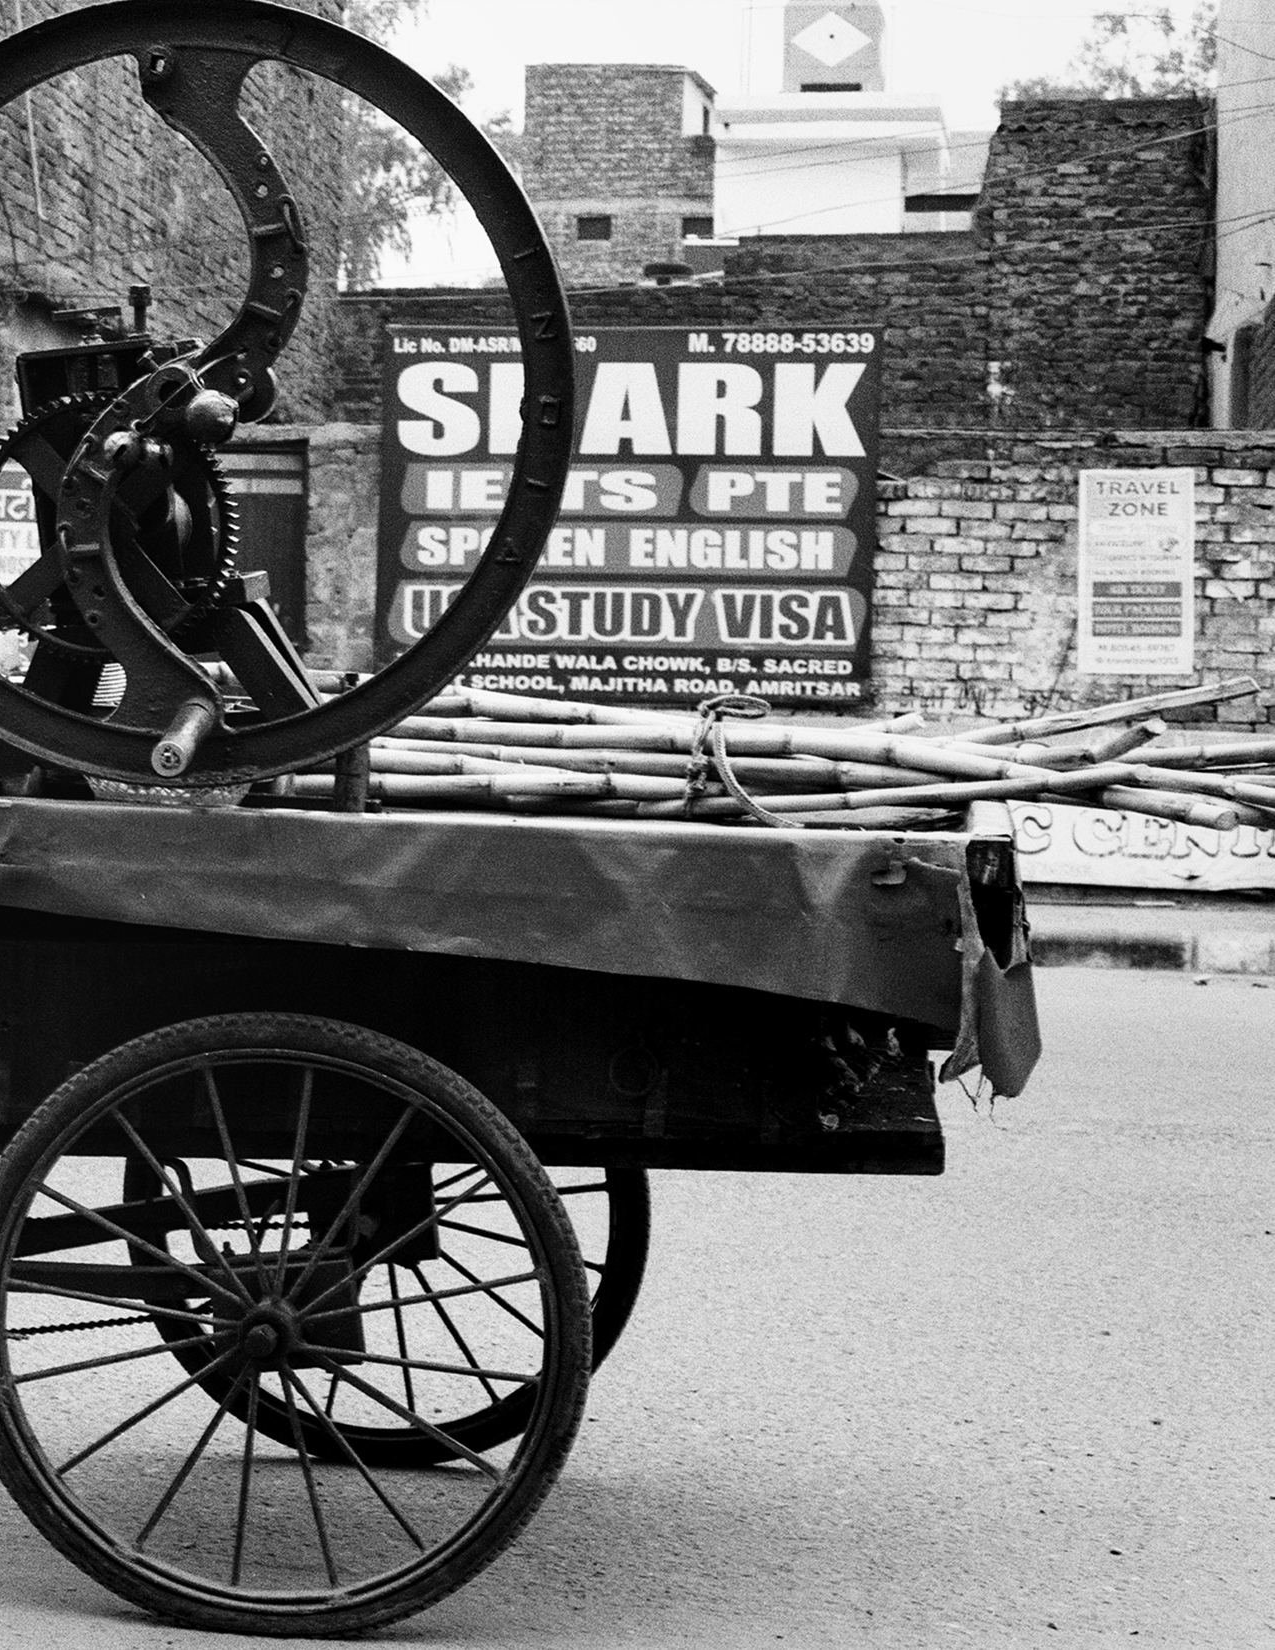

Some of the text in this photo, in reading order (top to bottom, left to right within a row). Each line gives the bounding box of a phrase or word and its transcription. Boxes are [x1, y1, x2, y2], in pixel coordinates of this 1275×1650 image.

[394, 336, 418, 353] Lic
[421, 336, 446, 353] No.
[688, 333, 716, 353] M.
[722, 333, 875, 353] 78888-53639
[426, 469, 843, 513] IETS PTE
[1096, 481, 1180, 495] TRAVEL
[1108, 502, 1168, 517] ZONE
[629, 529, 834, 571] ENGLISH
[522, 586, 706, 643] STUDY
[713, 588, 856, 646] VISA
[468, 653, 853, 676] HANDE WALA CHOWK, B/S. SACRED
[471, 675, 566, 694] SCHOOL,
[570, 676, 668, 693] MAJITHA
[746, 680, 861, 697] AMRITSAR
